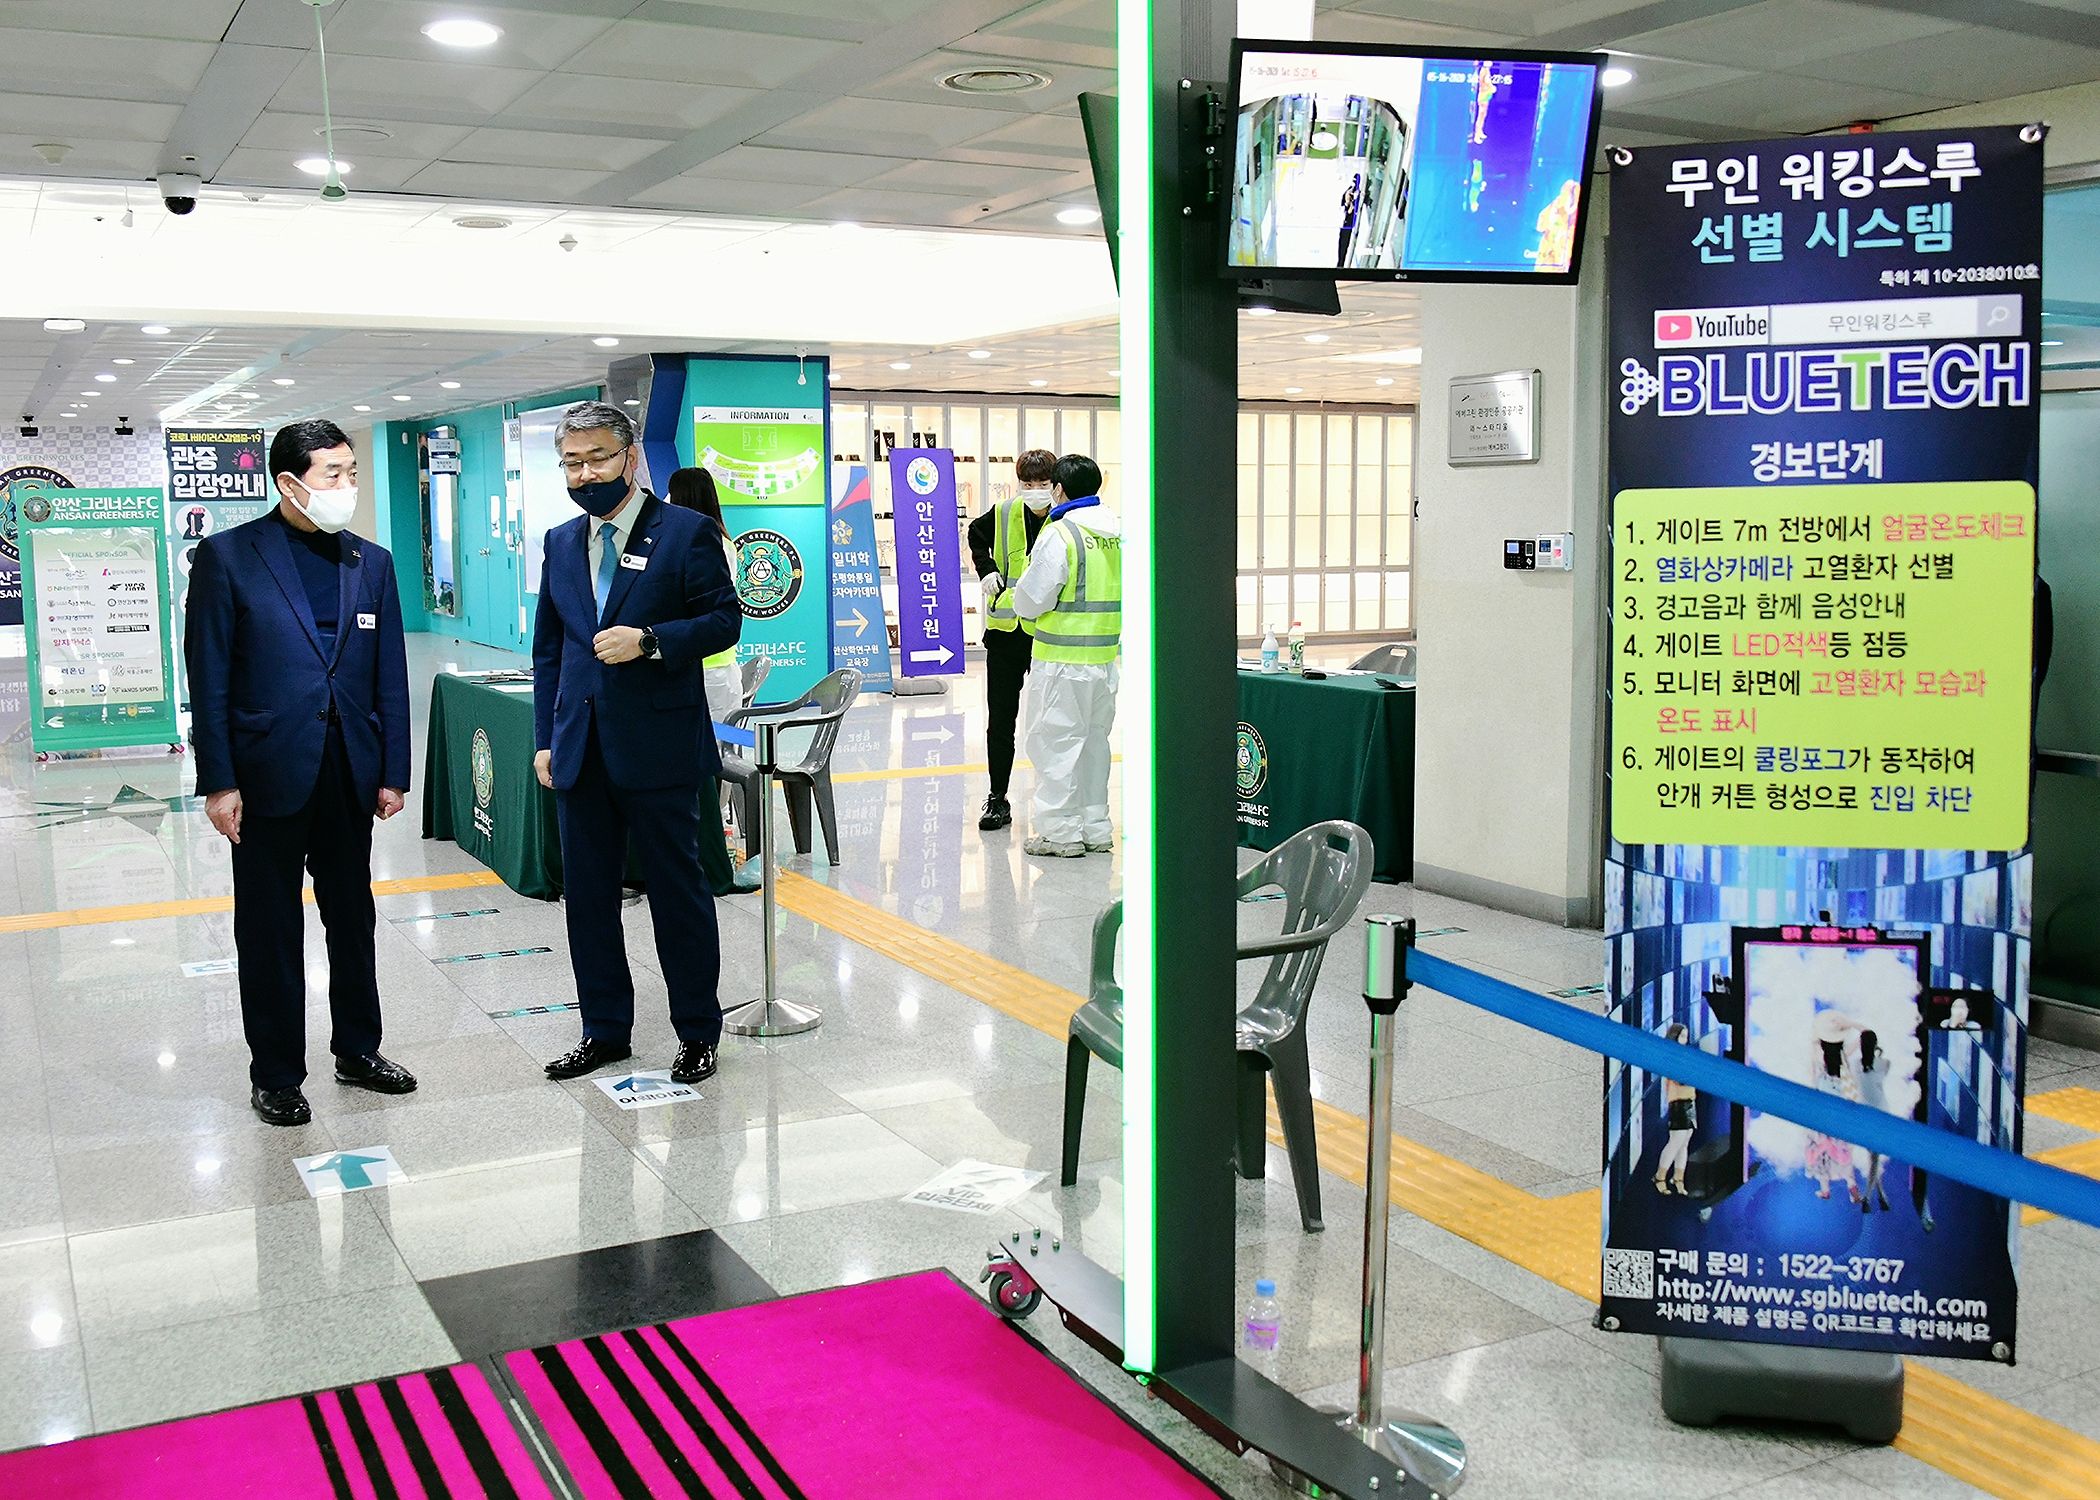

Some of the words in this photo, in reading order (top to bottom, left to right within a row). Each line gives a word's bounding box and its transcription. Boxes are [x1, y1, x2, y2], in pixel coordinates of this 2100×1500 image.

[1666, 155, 1760, 207] 무인
[1780, 142, 1981, 200] 워킹스루
[1692, 212, 1784, 264] 선별
[1805, 202, 1954, 257] 시스템
[1879, 268, 1909, 287] 특허
[1913, 268, 1929, 285] 제
[1933, 264, 2040, 284] 10-2038010호
[1696, 314, 1768, 338] YouTube
[1828, 312, 1933, 332] 무인워킹스루
[1657, 342, 2031, 416] BLUETECH
[730, 411, 790, 420] INFORMATION
[171, 446, 218, 471] 관중
[1750, 438, 1884, 481] 경보단계
[15, 469, 67, 486] GREENERS
[173, 473, 265, 498] 입장안내
[52, 496, 159, 512] 안산그리너스FC
[53, 511, 91, 521] ANSAN
[92, 510, 145, 520] GREENERS
[146, 510, 160, 519] FC
[748, 533, 788, 549] GREENERS
[1625, 521, 1645, 545] 1.
[1656, 518, 1724, 544] 게이트
[1733, 519, 1768, 542] 7m
[1778, 515, 1872, 542] 전방에서
[1881, 514, 2028, 541] 얼굴온도체크
[832, 551, 870, 568] 일대학
[915, 501, 941, 640] 안산학연구원
[1624, 558, 1645, 583] 2.
[1656, 555, 1793, 583] 열화상카메라
[1803, 554, 1898, 580] 고열환자
[1908, 553, 1954, 580] 선별
[0, 589, 22, 599] SAN
[1623, 596, 1645, 620] 3.
[1656, 594, 1747, 621] 경고음과
[1756, 594, 1802, 620] 함께
[1811, 593, 1906, 620] 음성안내
[761, 599, 789, 616] WOLVES
[735, 641, 807, 658] 산그리너스FC
[1623, 634, 1645, 658] 4.
[1655, 632, 1723, 659] 게이트
[1732, 632, 1852, 659] LED적색등
[1863, 632, 1908, 658] 점등
[795, 657, 807, 667] FC
[1623, 672, 1644, 696] 5.
[1654, 670, 1722, 696] 모니터
[1731, 670, 1801, 697] 화면에
[1809, 670, 1905, 697] 고열환자
[1914, 670, 1988, 697] 모습과
[1656, 707, 1702, 734] 온도
[1711, 707, 1759, 735] 표시
[1622, 746, 1643, 771] 6.
[1654, 745, 1744, 773] 게이트의
[1753, 746, 1871, 774] 쿨링포그가
[1879, 747, 1976, 775] 동작하여
[1656, 782, 1701, 809] 안개
[1711, 783, 1757, 810] 커튼
[1765, 783, 1858, 811] 형성으로
[1869, 785, 1915, 812] 진입
[1926, 785, 1973, 813] 차단
[947, 1187, 985, 1199] VIP
[1657, 1248, 1699, 1276] 구매
[1705, 1250, 1749, 1279] 문의
[1779, 1254, 1905, 1284] 1522-3767
[1657, 1277, 1988, 1319] http://www.sgbluetech.com
[1656, 1301, 1710, 1323] 자세한
[1712, 1304, 1750, 1327] 제품
[1753, 1307, 1809, 1331] 설명은
[1812, 1313, 1895, 1335] QR코드로
[1899, 1316, 1992, 1344] 확인하세요
